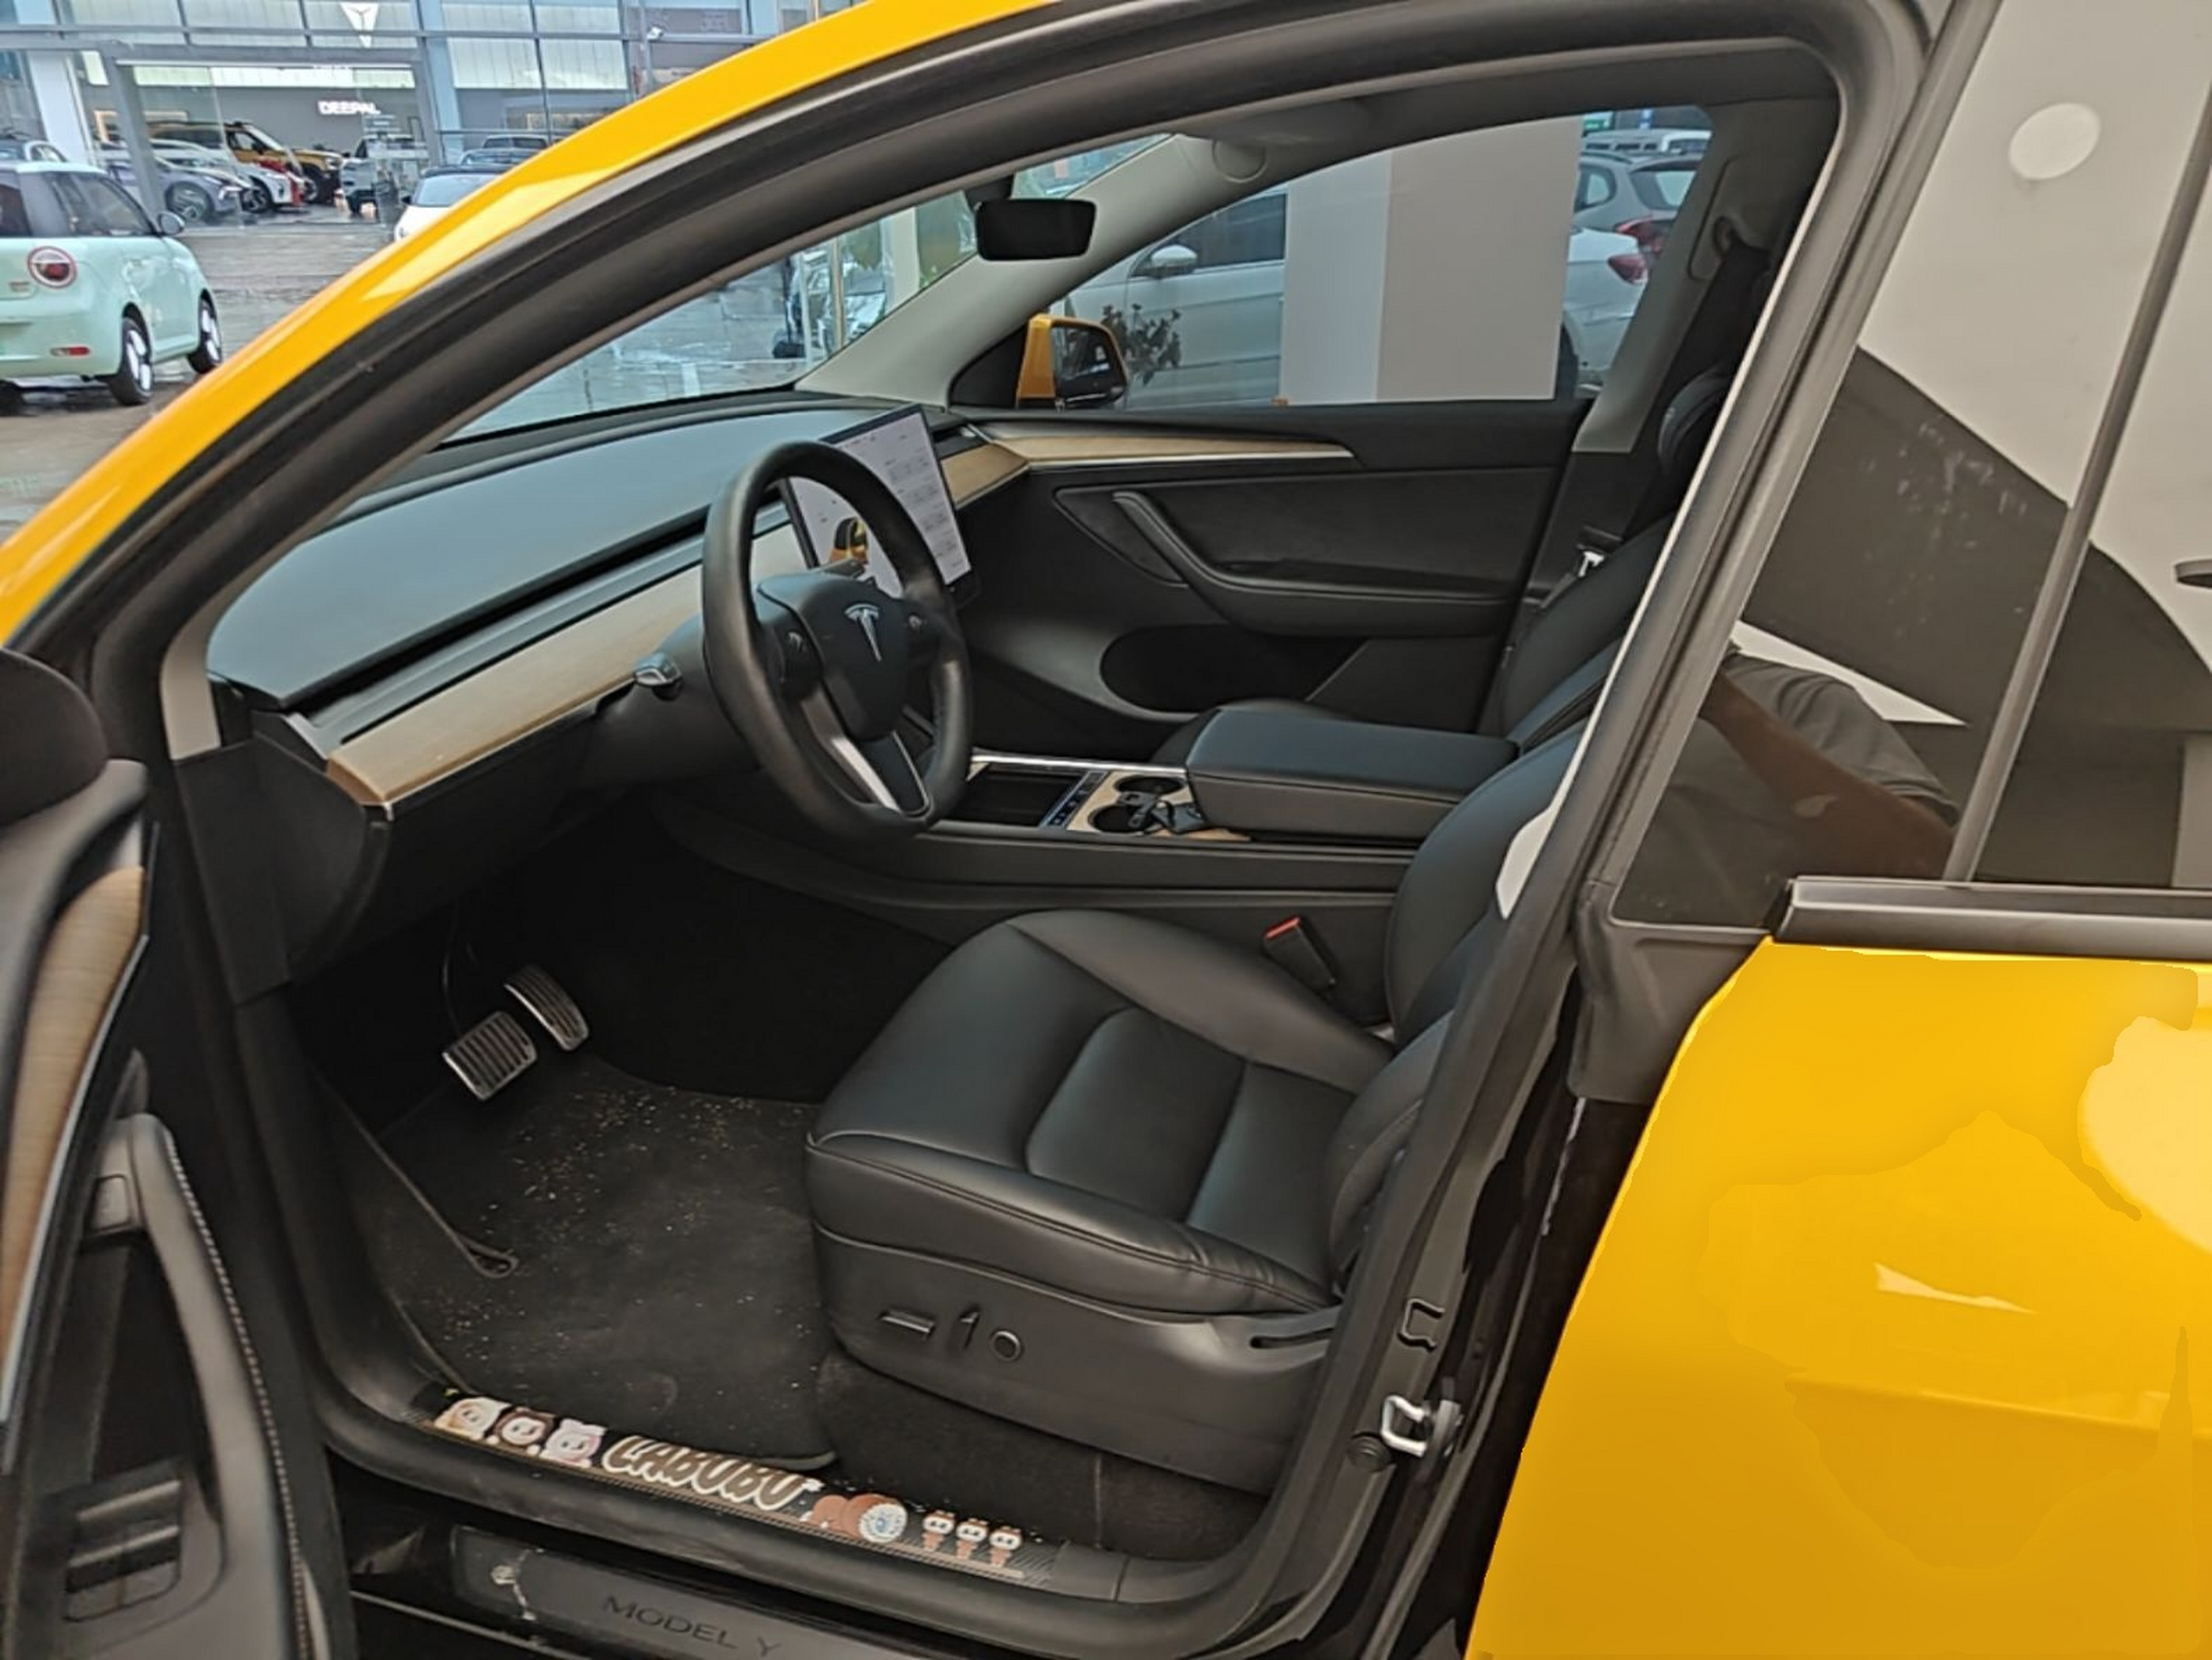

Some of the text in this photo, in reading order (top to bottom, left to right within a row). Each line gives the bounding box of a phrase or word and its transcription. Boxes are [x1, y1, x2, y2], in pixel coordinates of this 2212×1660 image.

[317, 100, 381, 115] DEEPAL
[605, 1595, 781, 1657] MODEL Y
